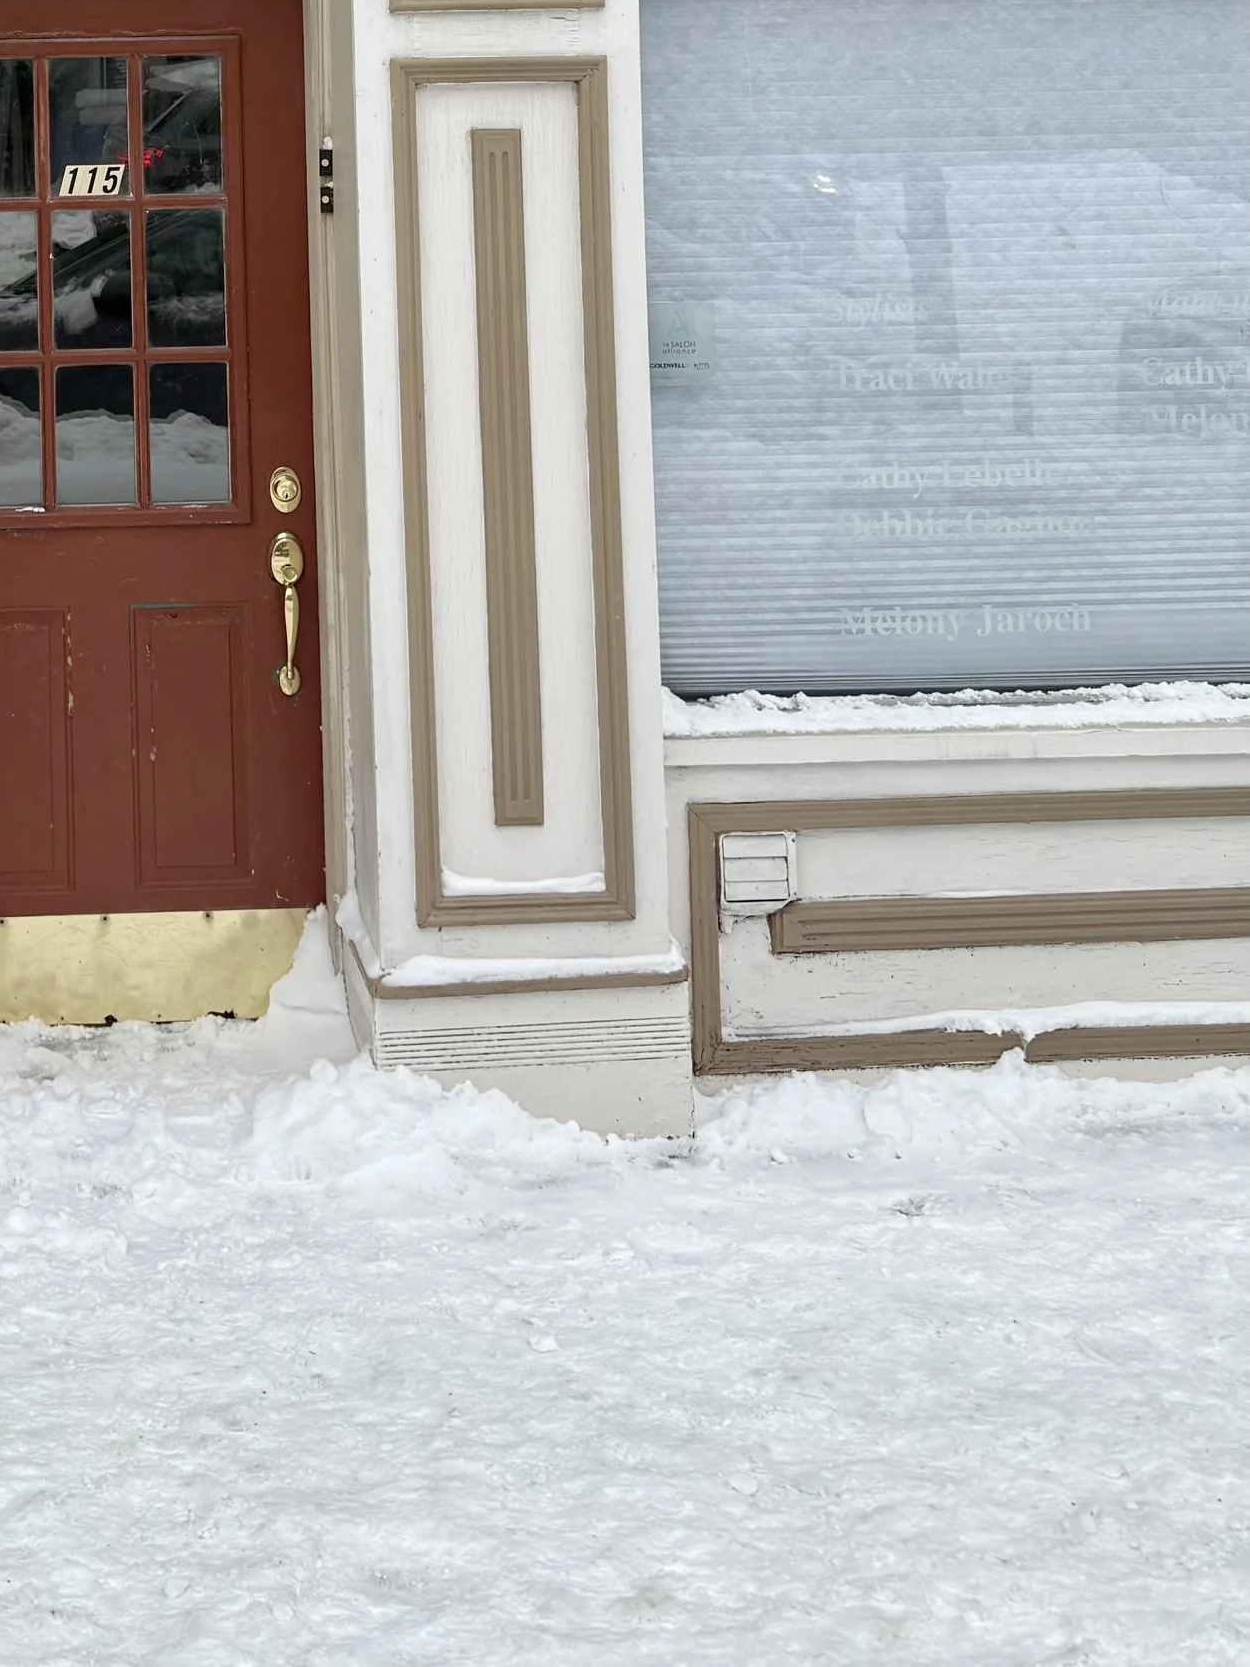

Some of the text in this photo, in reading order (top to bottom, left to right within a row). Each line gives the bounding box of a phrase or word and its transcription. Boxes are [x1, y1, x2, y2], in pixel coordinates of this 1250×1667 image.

[67, 166, 120, 195] 115
[838, 602, 1093, 642] Melony Jaroch
